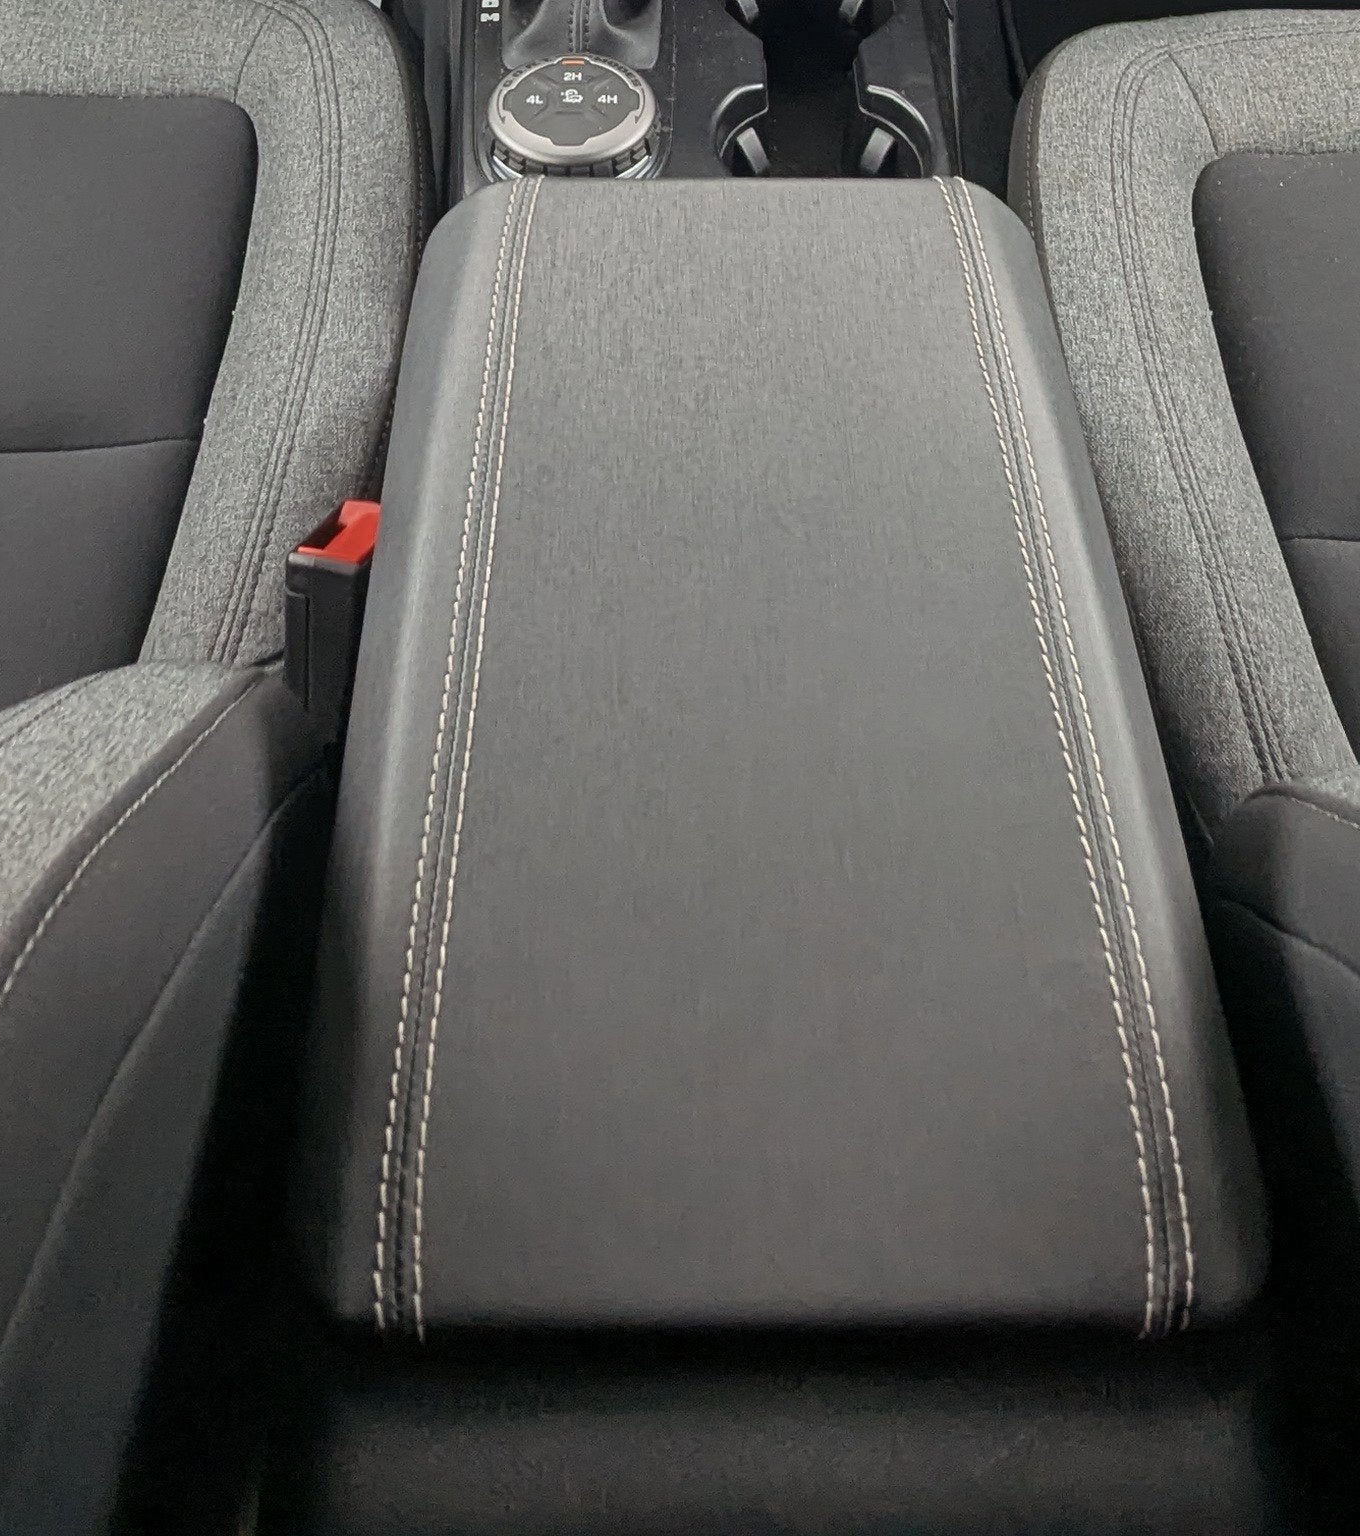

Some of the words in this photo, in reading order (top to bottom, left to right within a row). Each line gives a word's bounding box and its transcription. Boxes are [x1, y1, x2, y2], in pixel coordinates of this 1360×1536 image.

[563, 71, 583, 81] 2H
[525, 94, 544, 105] 4L
[597, 94, 619, 105] 4H
